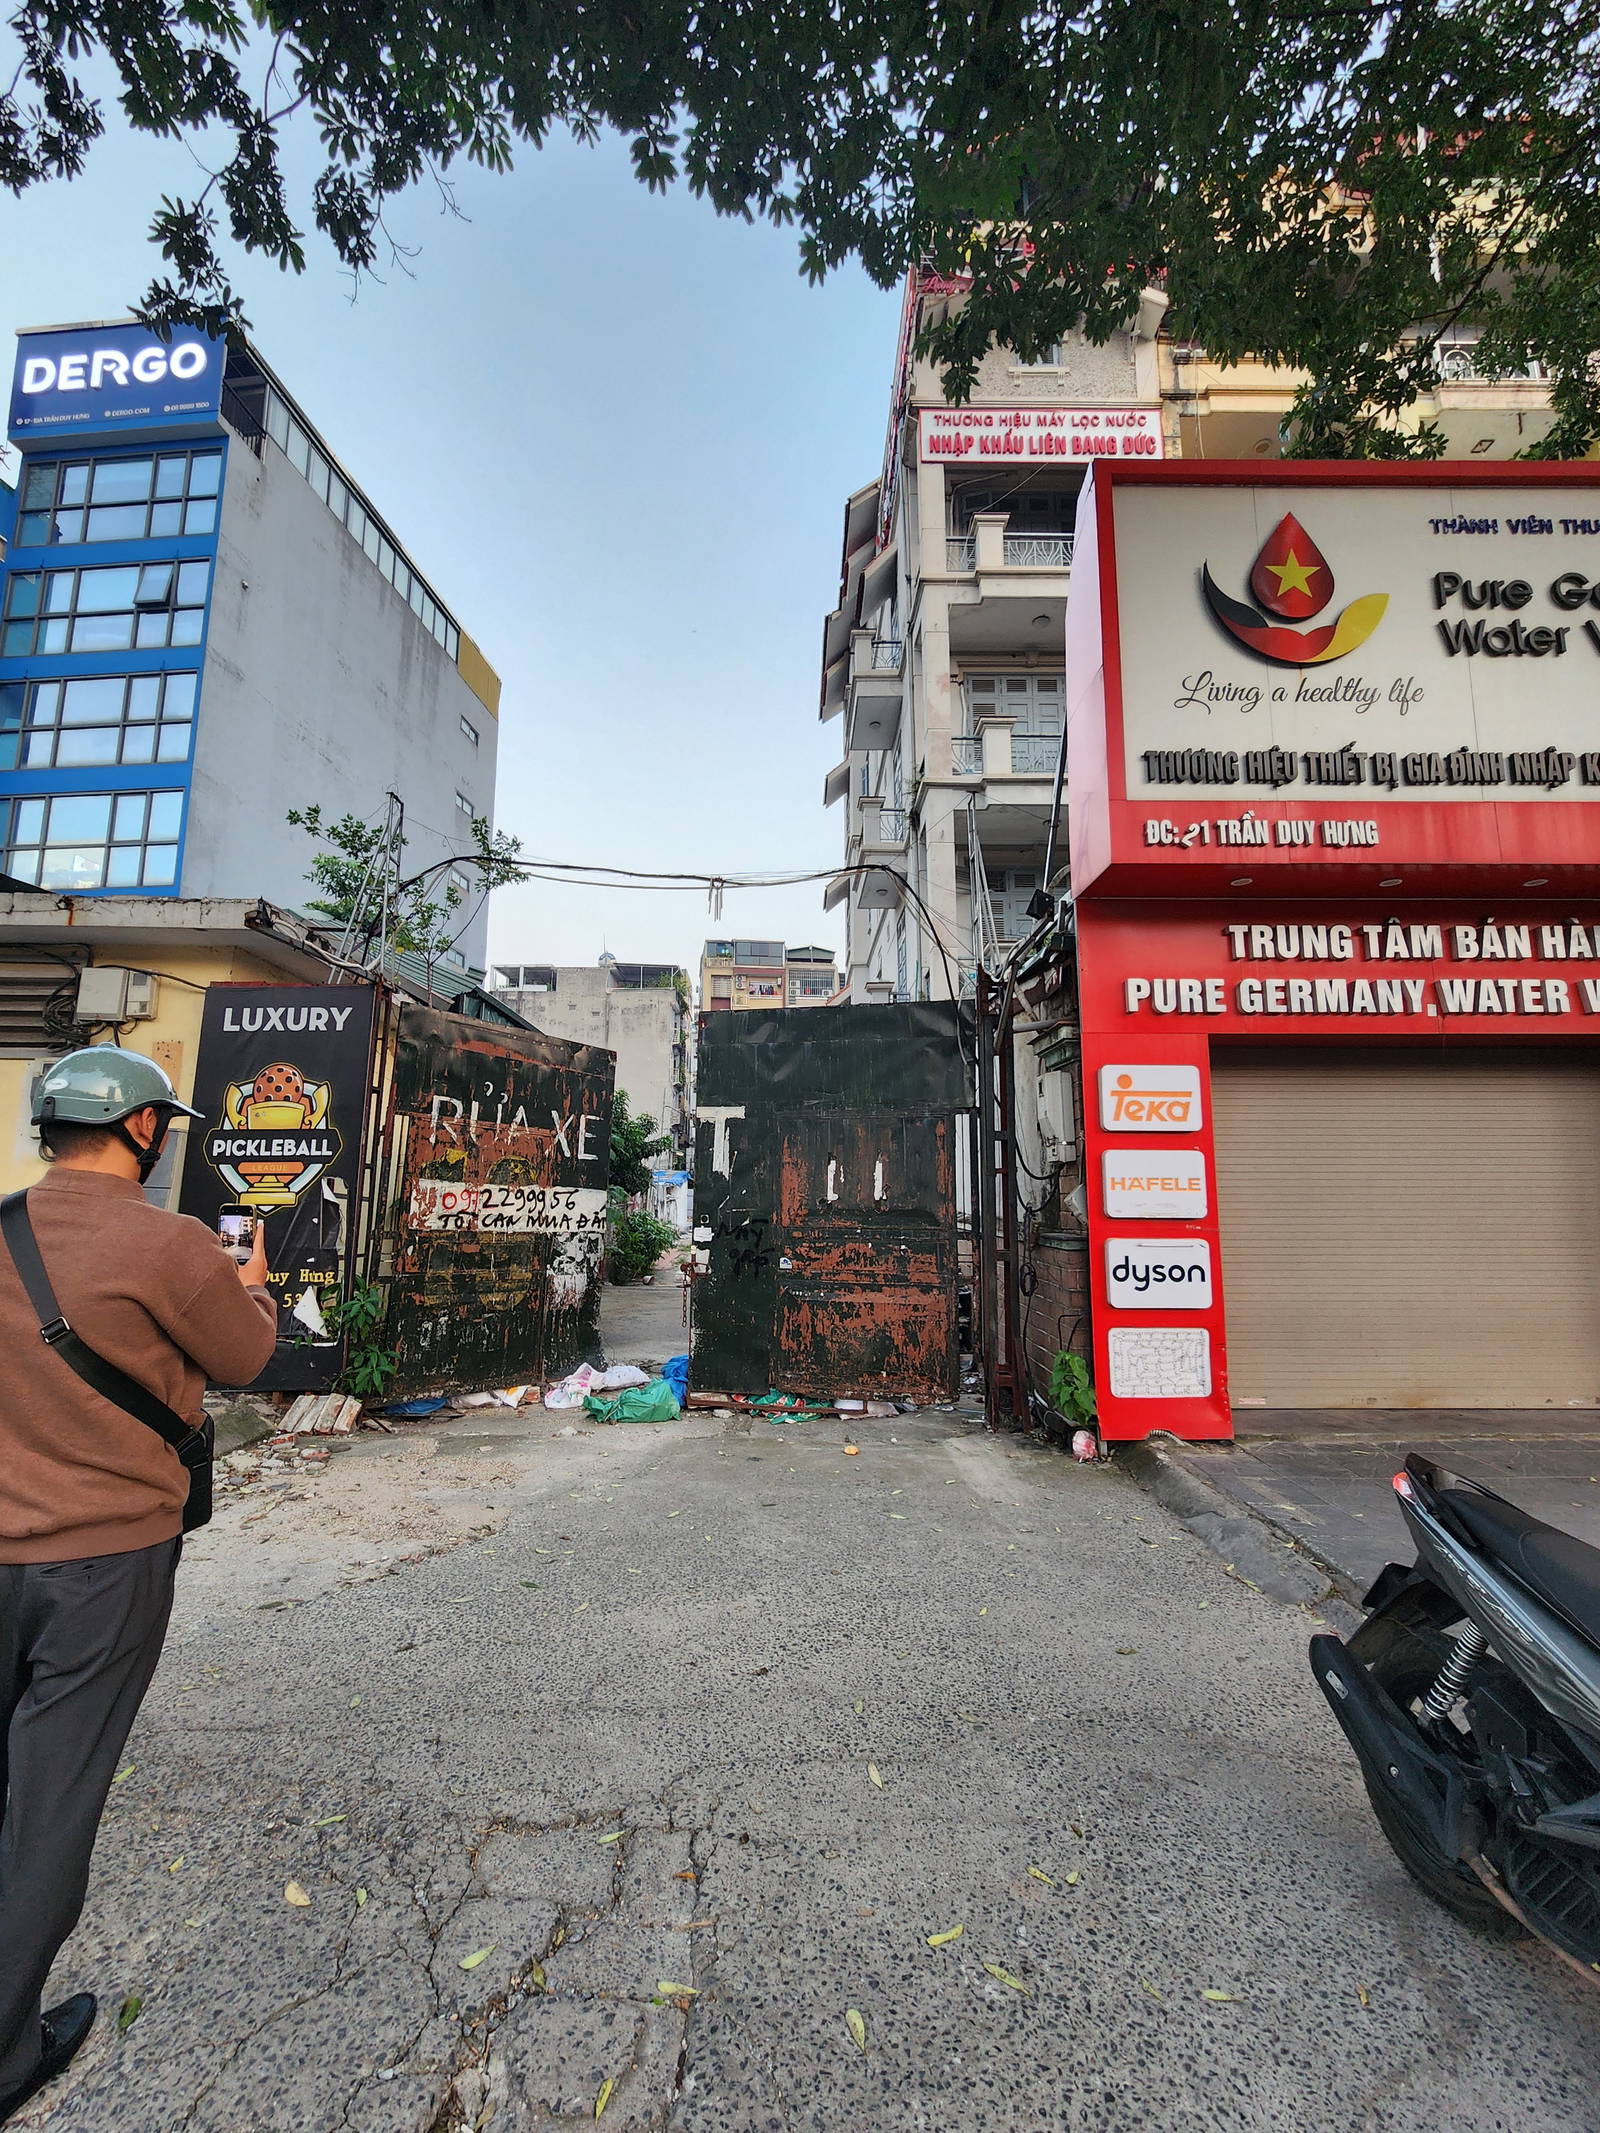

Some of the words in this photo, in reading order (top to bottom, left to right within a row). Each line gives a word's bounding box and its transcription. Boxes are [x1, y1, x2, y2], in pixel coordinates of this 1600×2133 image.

[22, 342, 207, 394] DERGO
[934, 413, 993, 427] THƯƠNG
[999, 413, 1031, 429] HIỆU
[1037, 413, 1066, 427] MÁY
[1071, 415, 1100, 430] LỌC
[1106, 412, 1147, 427] NƯỚC
[929, 432, 974, 457] NHẬP
[1029, 432, 1066, 455] LIÊN
[1072, 435, 1117, 455] BANG
[1122, 431, 1157, 455] ĐỨC
[1429, 514, 1498, 535] THÀNH
[1505, 514, 1553, 535] VIÊN
[1433, 572, 1533, 610] Pure
[1437, 619, 1570, 657] Water
[1174, 670, 1264, 715] Living
[1271, 686, 1288, 703] a
[1295, 676, 1381, 714] healthy
[1388, 676, 1424, 716] life
[1143, 748, 1240, 783] THƯƠNG
[1246, 745, 1298, 789] HIỆU
[1302, 741, 1367, 785] THIẾT
[1371, 752, 1399, 791] BỊ
[1402, 752, 1446, 785] GIA
[1446, 746, 1505, 785] ĐÌNH
[1508, 746, 1576, 791] NHẬP
[1216, 810, 1269, 846] TRẦN
[1276, 820, 1315, 846] DUY
[1322, 819, 1379, 847] HƯNG
[1227, 924, 1354, 960] TRUNG
[1361, 917, 1444, 960] TÂM
[1453, 916, 1532, 959] BÁN
[1540, 917, 1600, 959] HÀ
[1125, 978, 1227, 1014] PURE
[223, 1007, 353, 1032] LUXURY
[212, 1138, 333, 1156] PICKLEBALL
[550, 1110, 604, 1160] XE
[1110, 1177, 1201, 1192] HÄFELE
[526, 1212, 572, 1229] MUA
[1112, 1255, 1206, 1292] dyson
